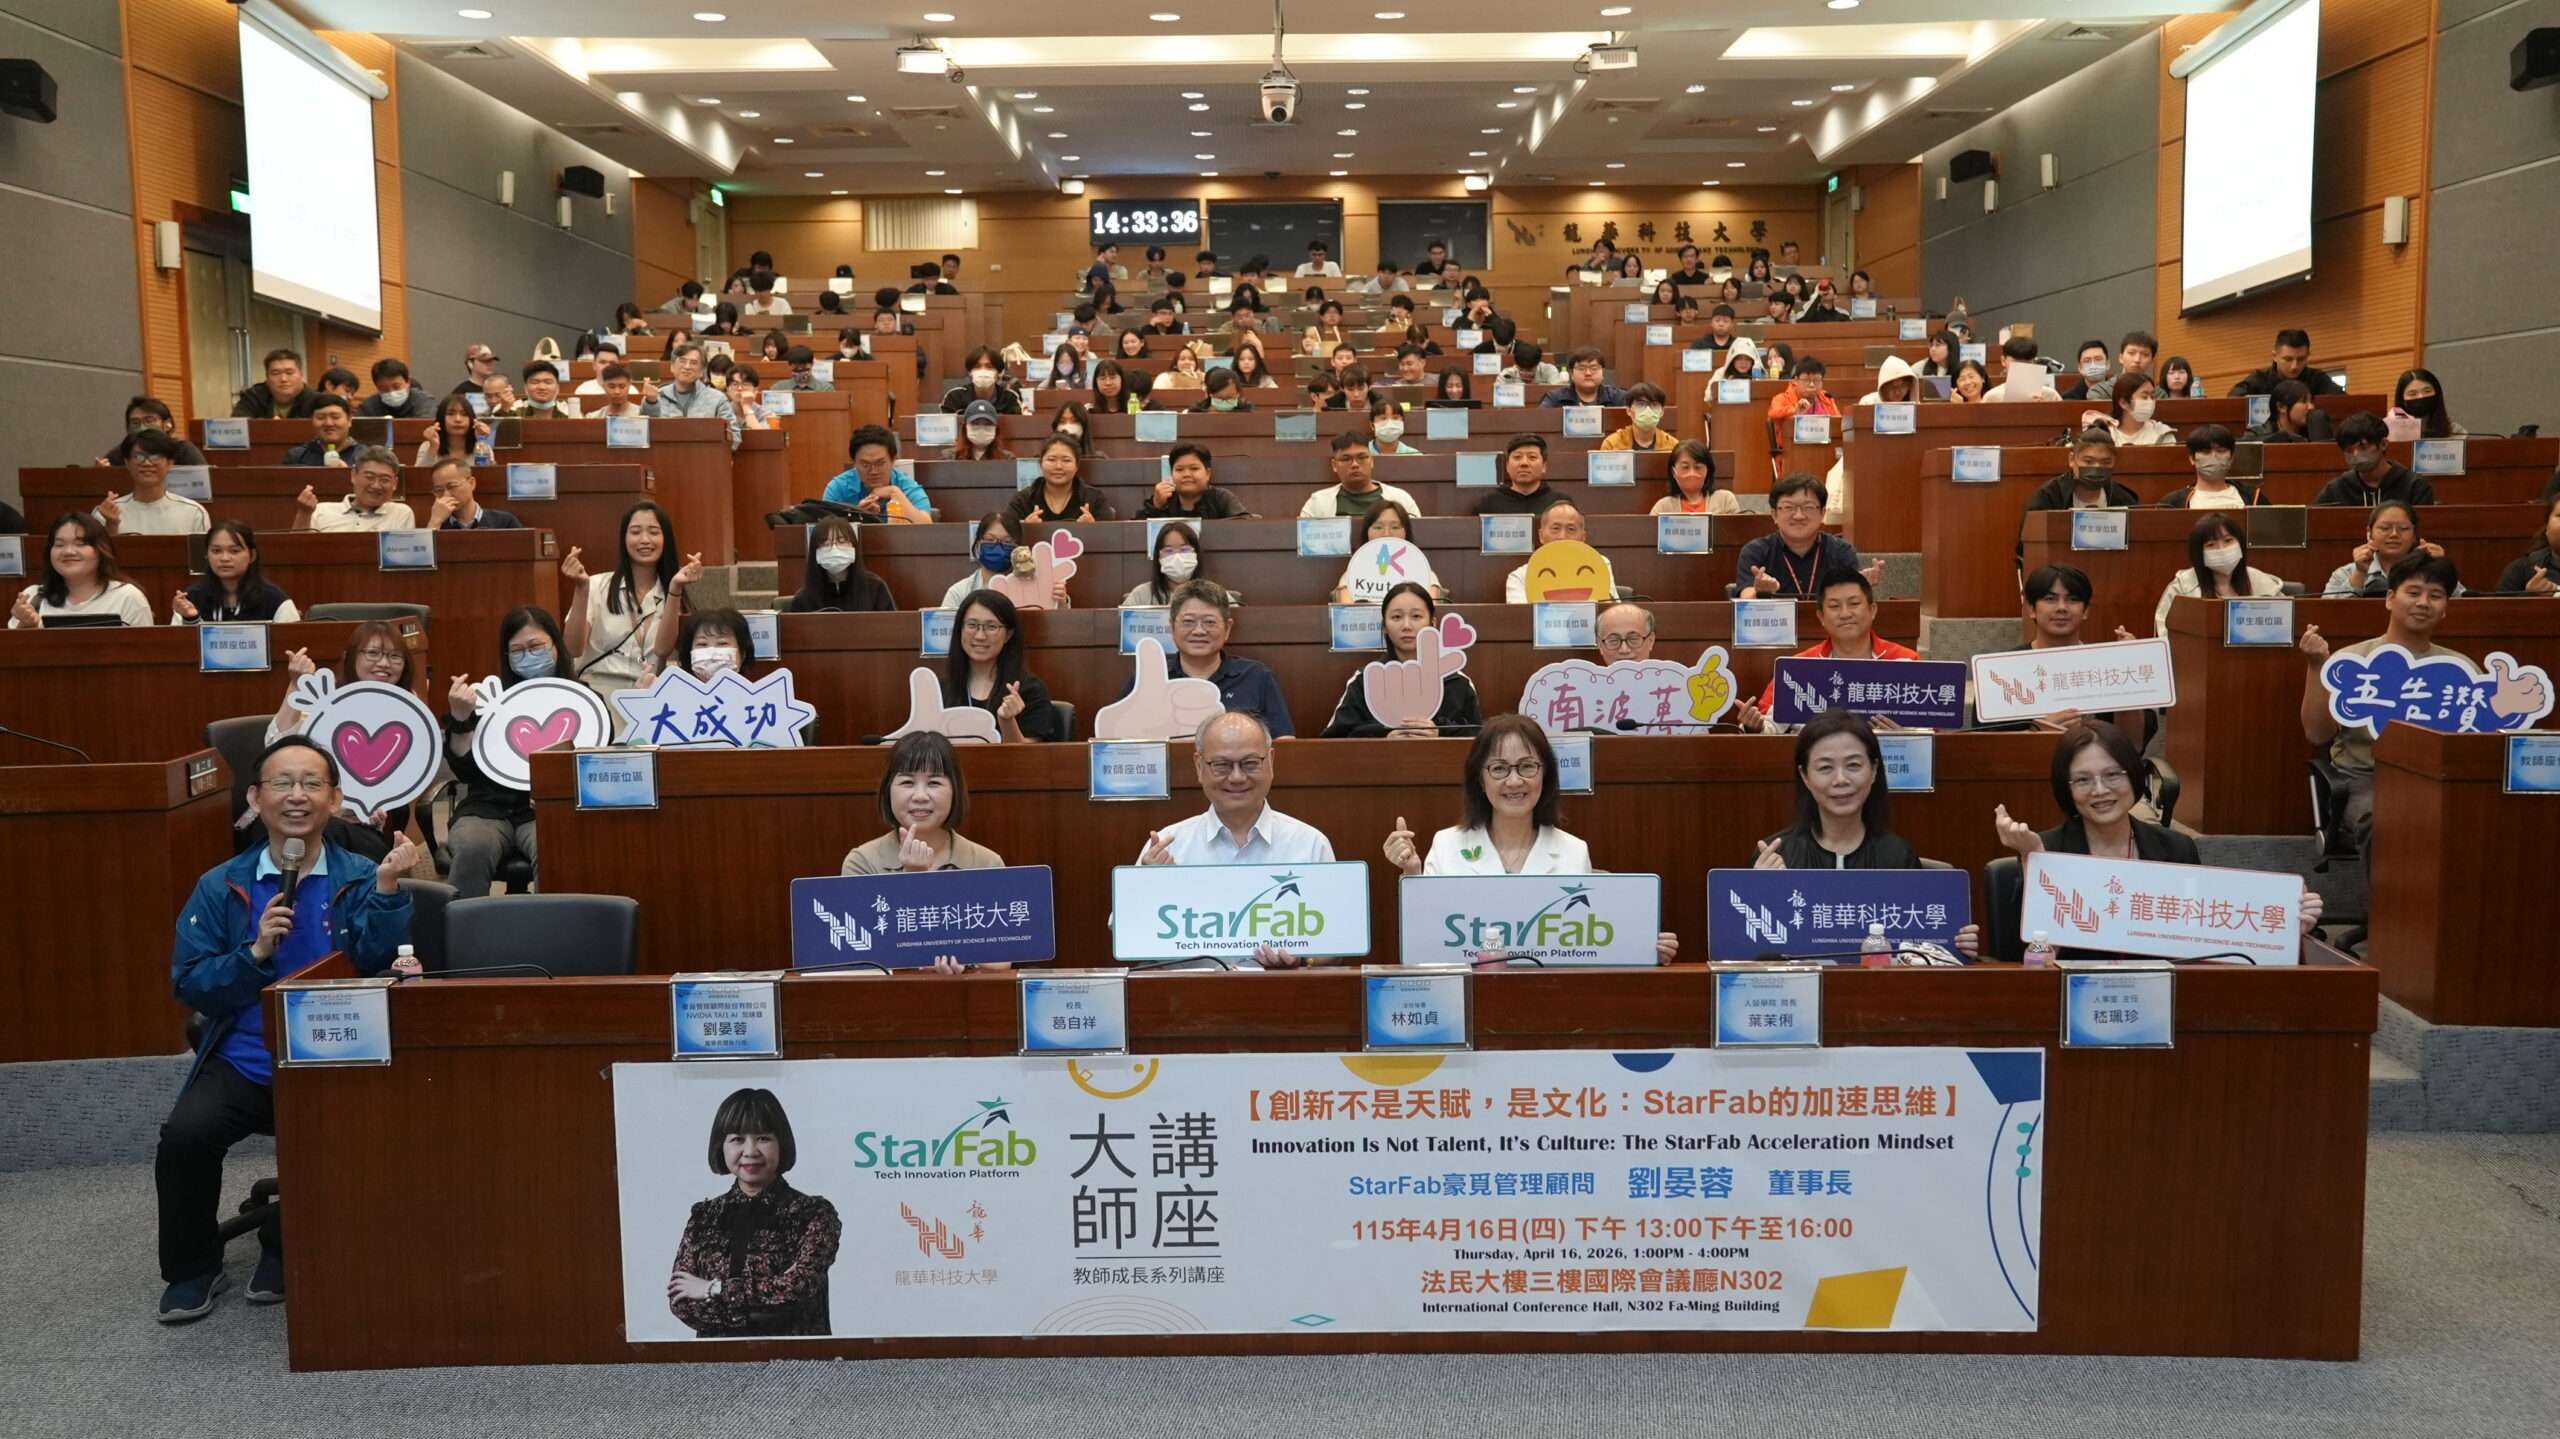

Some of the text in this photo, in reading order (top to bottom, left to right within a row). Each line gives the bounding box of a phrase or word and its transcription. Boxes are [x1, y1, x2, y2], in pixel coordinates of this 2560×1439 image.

[1093, 211, 1199, 234] 14:33:36
[1563, 220, 1768, 243] 龍華科技大學
[1355, 579, 1391, 593] Kyut
[2053, 664, 2155, 691] 龍華科技大學
[1847, 682, 1957, 705] 龍華科技大學
[650, 696, 776, 746] 大成功
[587, 770, 643, 783] 教師座位區
[1103, 763, 1157, 775] 教師座位區
[896, 900, 1031, 934] 龍華科技大學
[1157, 902, 1325, 939] StarFab
[1811, 903, 1948, 929] 龍華科技大學
[2129, 893, 2287, 934] 龍華科技大學
[1175, 940, 1200, 950] Tech
[1203, 939, 1259, 950] Innovation
[1462, 949, 1480, 958] Tec
[1551, 949, 1598, 958] Platform
[704, 1021, 748, 1037] 劉晏蓉
[1052, 1015, 1097, 1030] 葛自祥
[1392, 1011, 1440, 1026] 林如貞
[312, 1027, 358, 1043] 陳元和
[853, 1130, 1037, 1168] StarFab
[1252, 1133, 1954, 1155] Innovation Is Not Talent, It's Culture: The StarFab Acceleration Mindset
[874, 1168, 1020, 1180] Tech Innovation Platform
[1349, 1166, 1853, 1199] StarFab豪覓管理顧問 劉晏蓉 董事長
[1352, 1215, 1853, 1244] 115年4月16日(四) 下午 13:00下午至16:00
[1453, 1248, 1519, 1262] Thursday,
[1523, 1248, 1555, 1262] April
[1560, 1248, 1582, 1260] 16,
[1586, 1248, 1628, 1260] 2026,
[1633, 1247, 1684, 1259] 1:00PM
[1697, 1247, 1749, 1259] 4:00PM
[895, 1268, 998, 1287] 龍華科技大學
[1072, 1266, 1225, 1286] 教師成長系列講座
[1421, 1267, 1783, 1295] 法民大樓三樓國際會議廳N302
[1422, 1300, 1780, 1314] International Conference Hall, N302 Fa-Ming Building
